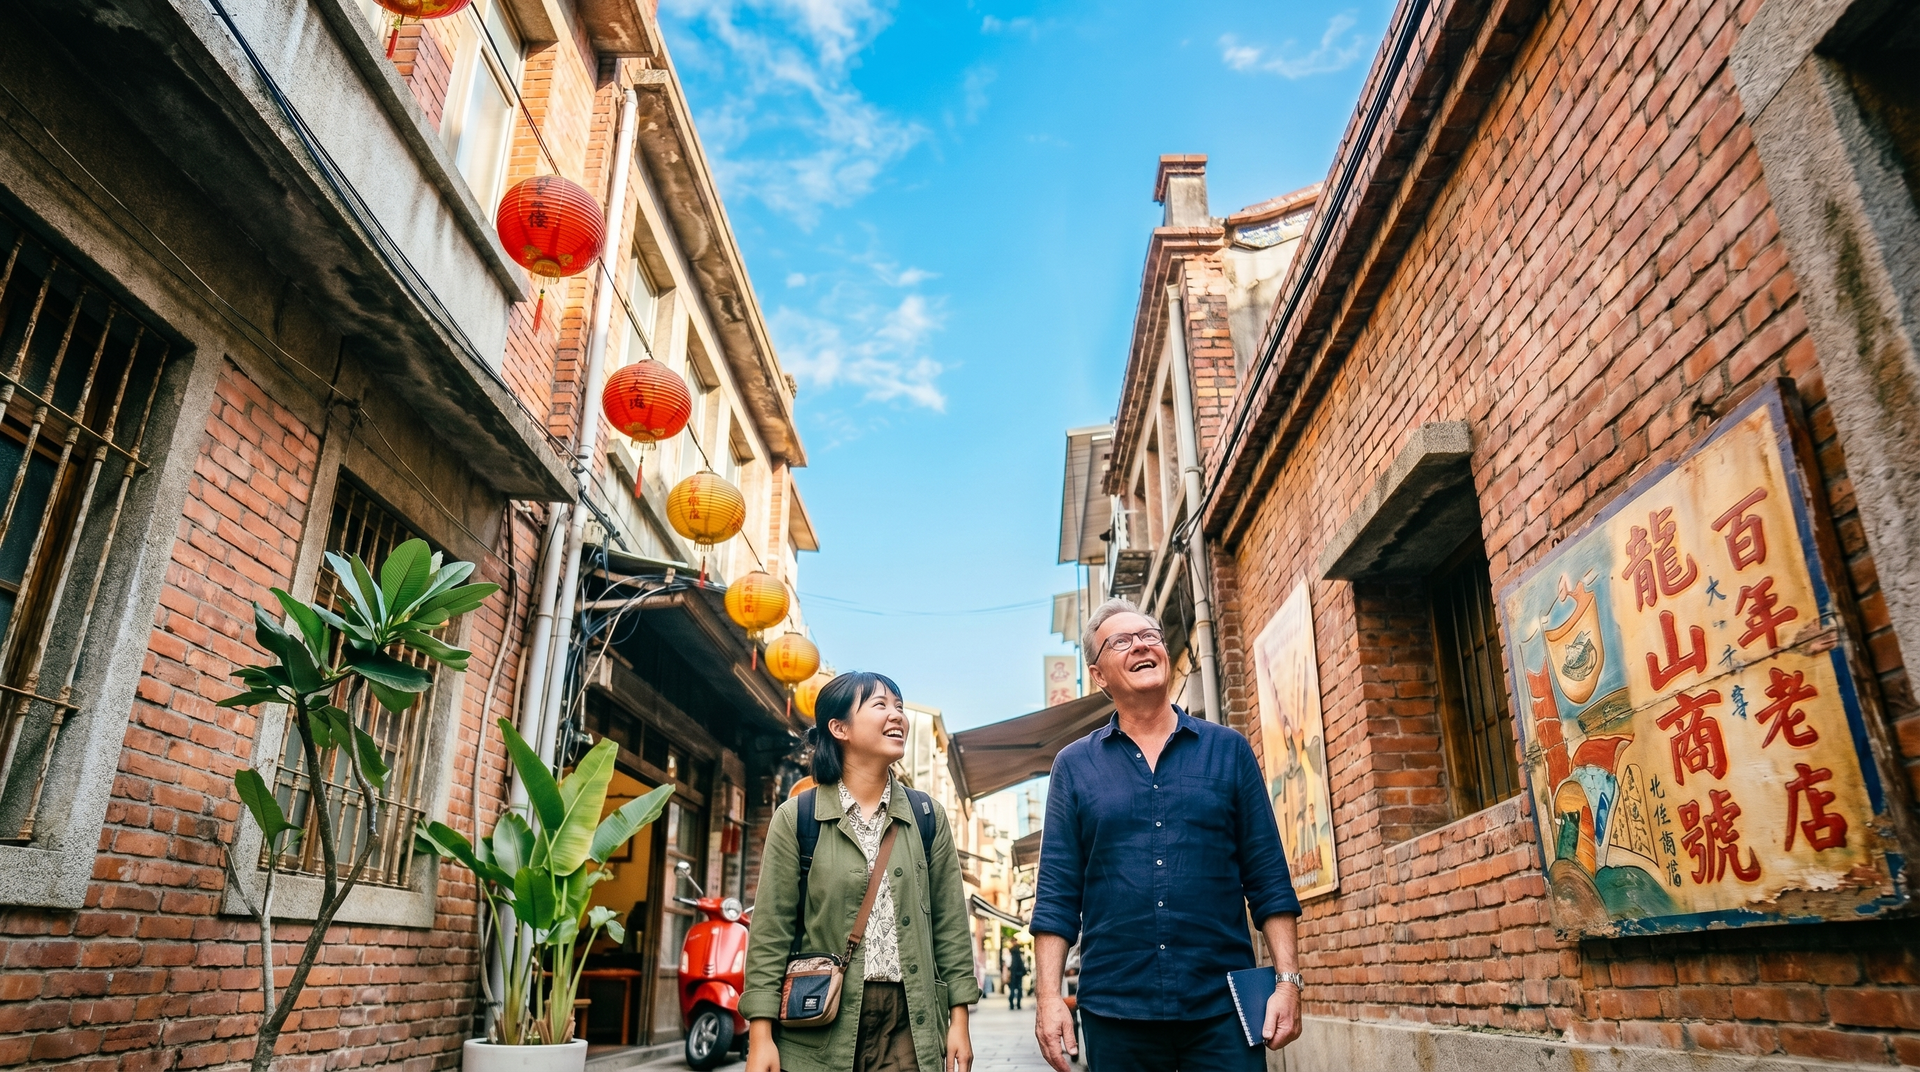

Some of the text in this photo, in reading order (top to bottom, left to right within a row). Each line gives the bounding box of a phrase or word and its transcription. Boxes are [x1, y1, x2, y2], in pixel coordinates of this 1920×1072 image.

[1622, 506, 1761, 884] 龍山商號
[1711, 487, 1848, 852] 百年老店
